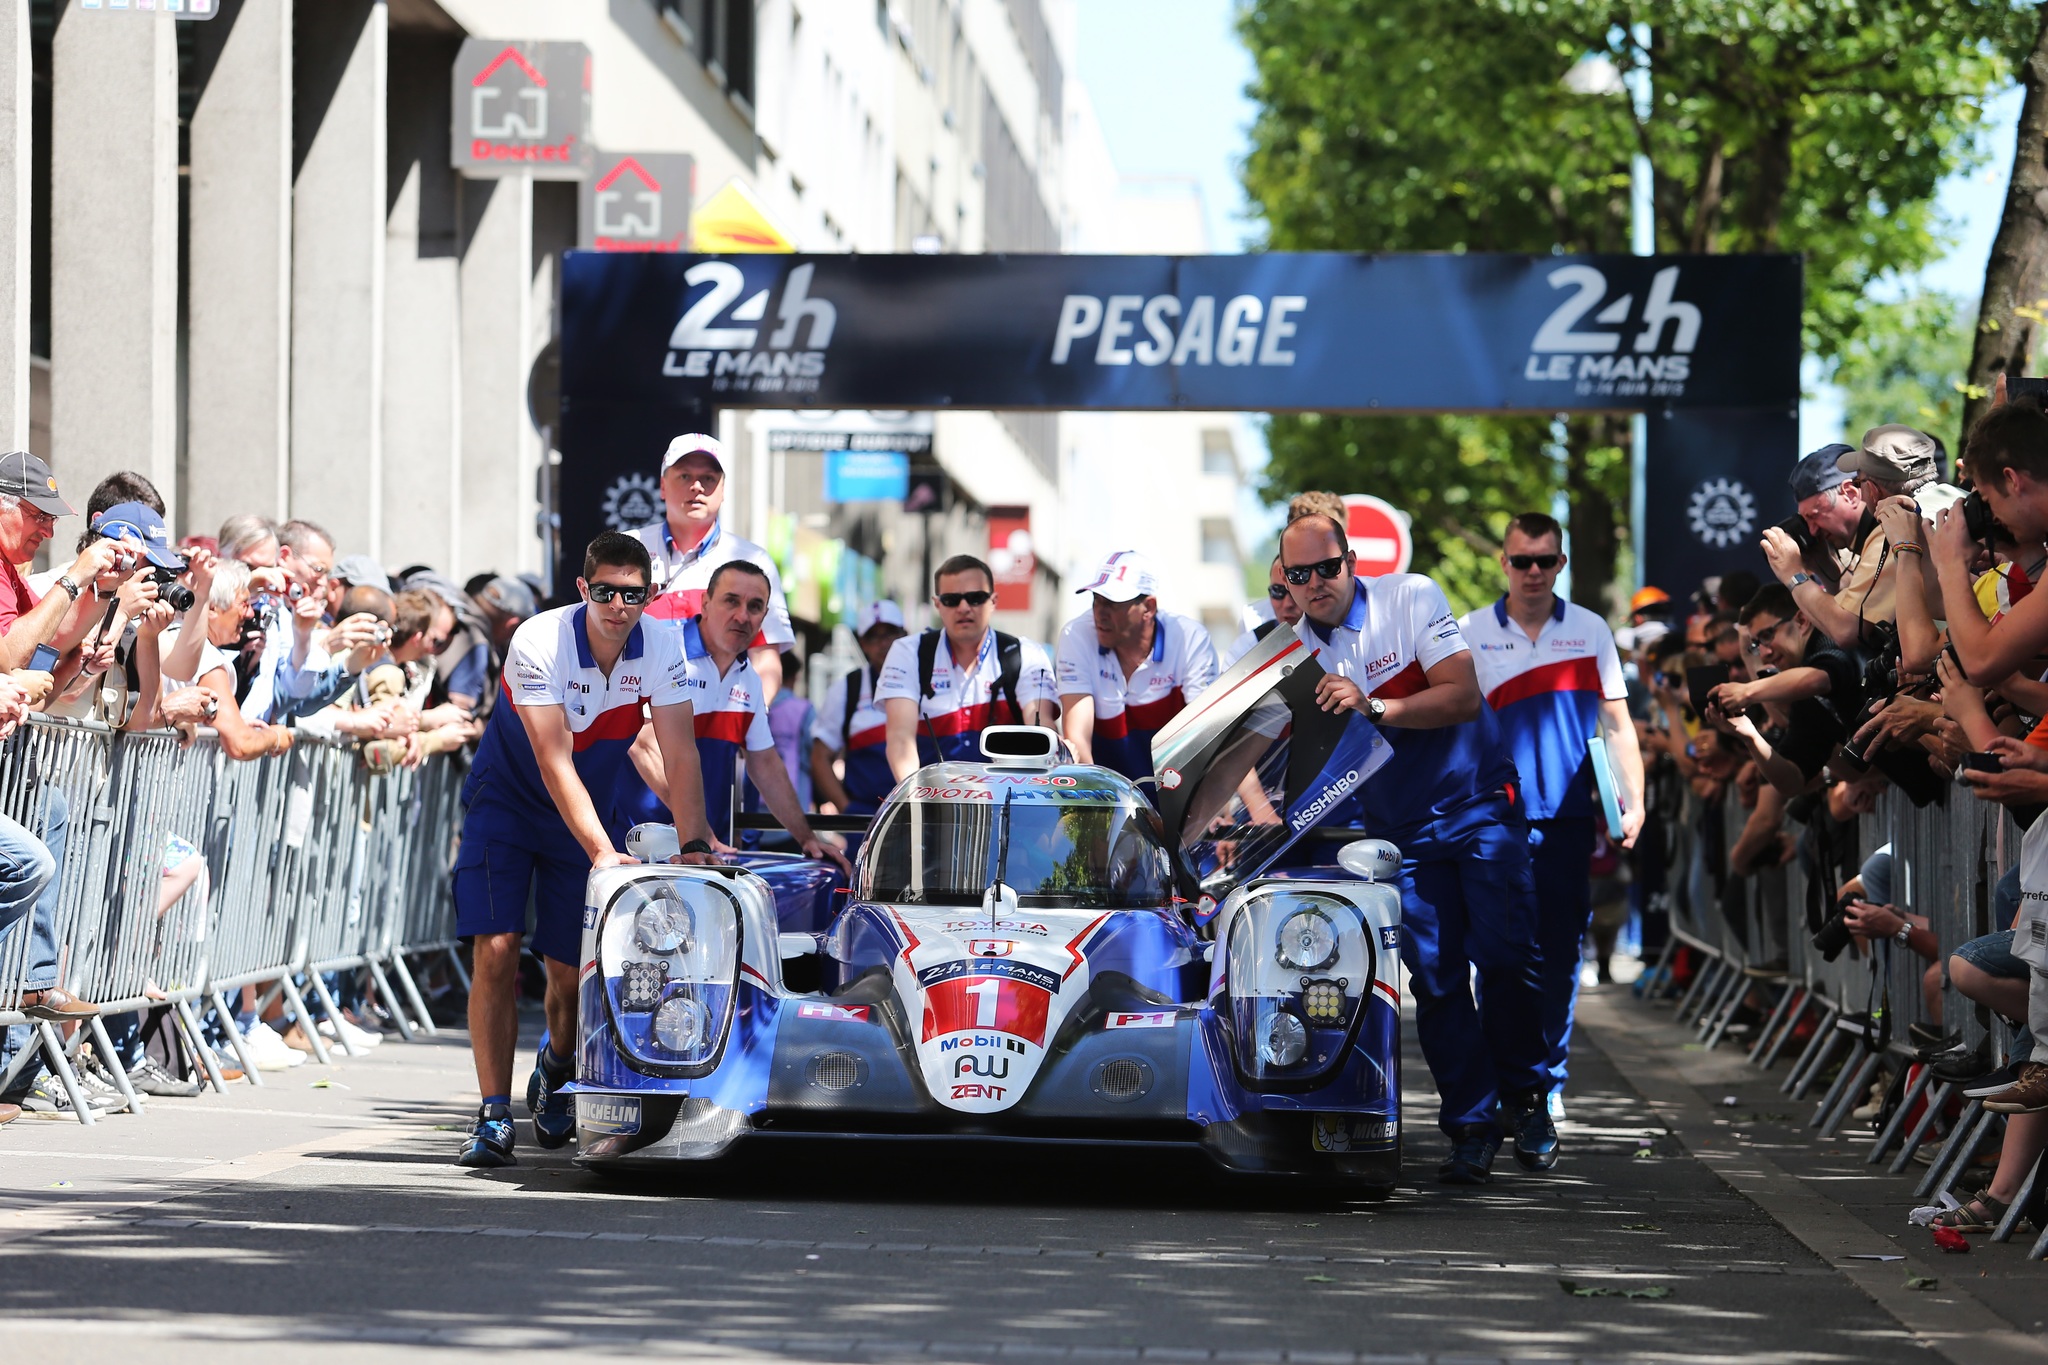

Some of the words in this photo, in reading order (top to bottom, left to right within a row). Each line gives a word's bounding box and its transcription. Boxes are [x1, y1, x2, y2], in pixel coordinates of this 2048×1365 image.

[669, 261, 837, 350] 24h
[1531, 264, 1702, 352] 24h
[1052, 295, 1307, 366] PESAGE
[662, 351, 713, 377] LE
[714, 351, 825, 377] MANS
[1524, 354, 1575, 380] LE
[1577, 354, 1690, 380] MANS
[1115, 565, 1128, 581] 1
[948, 774, 1077, 787] DENSO
[906, 786, 994, 800] TOYOTA
[1010, 789, 1121, 802] HYBRID
[1291, 769, 1360, 832] NISSHINBO
[941, 920, 1048, 931] TOYOTA
[996, 964, 1055, 985] MANS
[802, 1004, 866, 1019] HY
[966, 978, 1000, 1027] 1
[1116, 1013, 1165, 1026] P1
[941, 1035, 1001, 1052] Mobil
[1009, 1039, 1023, 1055] 1
[950, 1083, 1007, 1101] ZENT
[580, 1100, 638, 1122] MICHELIN
